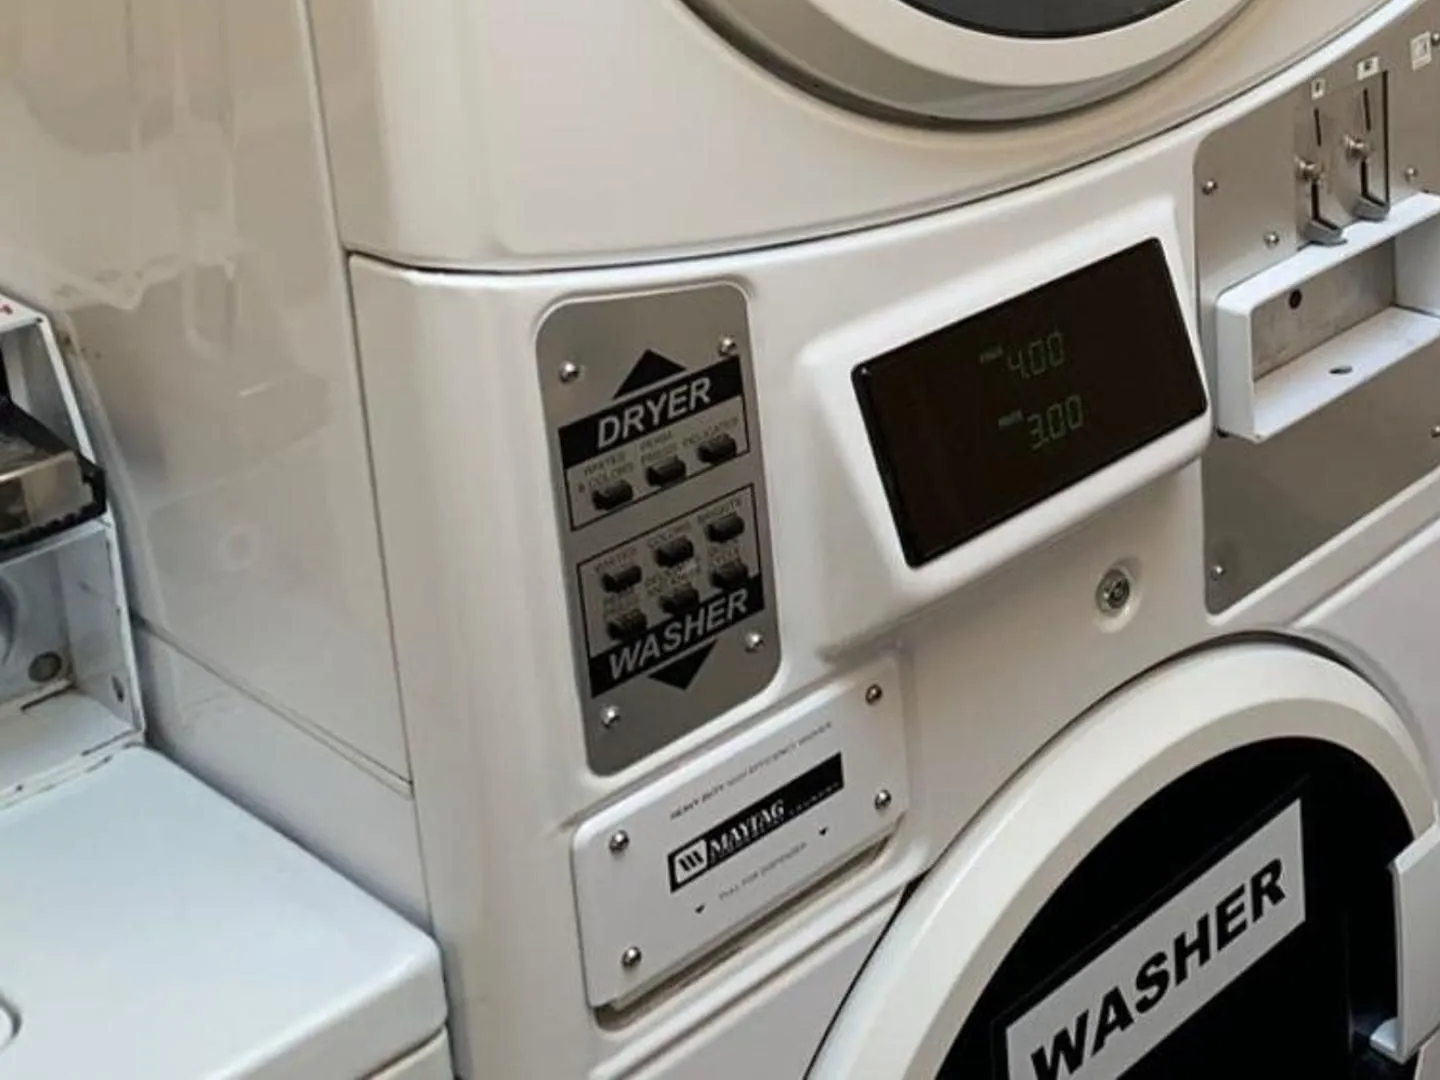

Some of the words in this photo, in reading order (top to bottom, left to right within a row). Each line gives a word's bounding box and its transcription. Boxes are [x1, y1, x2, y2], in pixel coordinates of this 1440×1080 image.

[596, 376, 712, 449] DRYER
[609, 588, 747, 680] WASHER
[709, 798, 785, 865] MAYTAG
[1031, 858, 1287, 1080] WASHER
